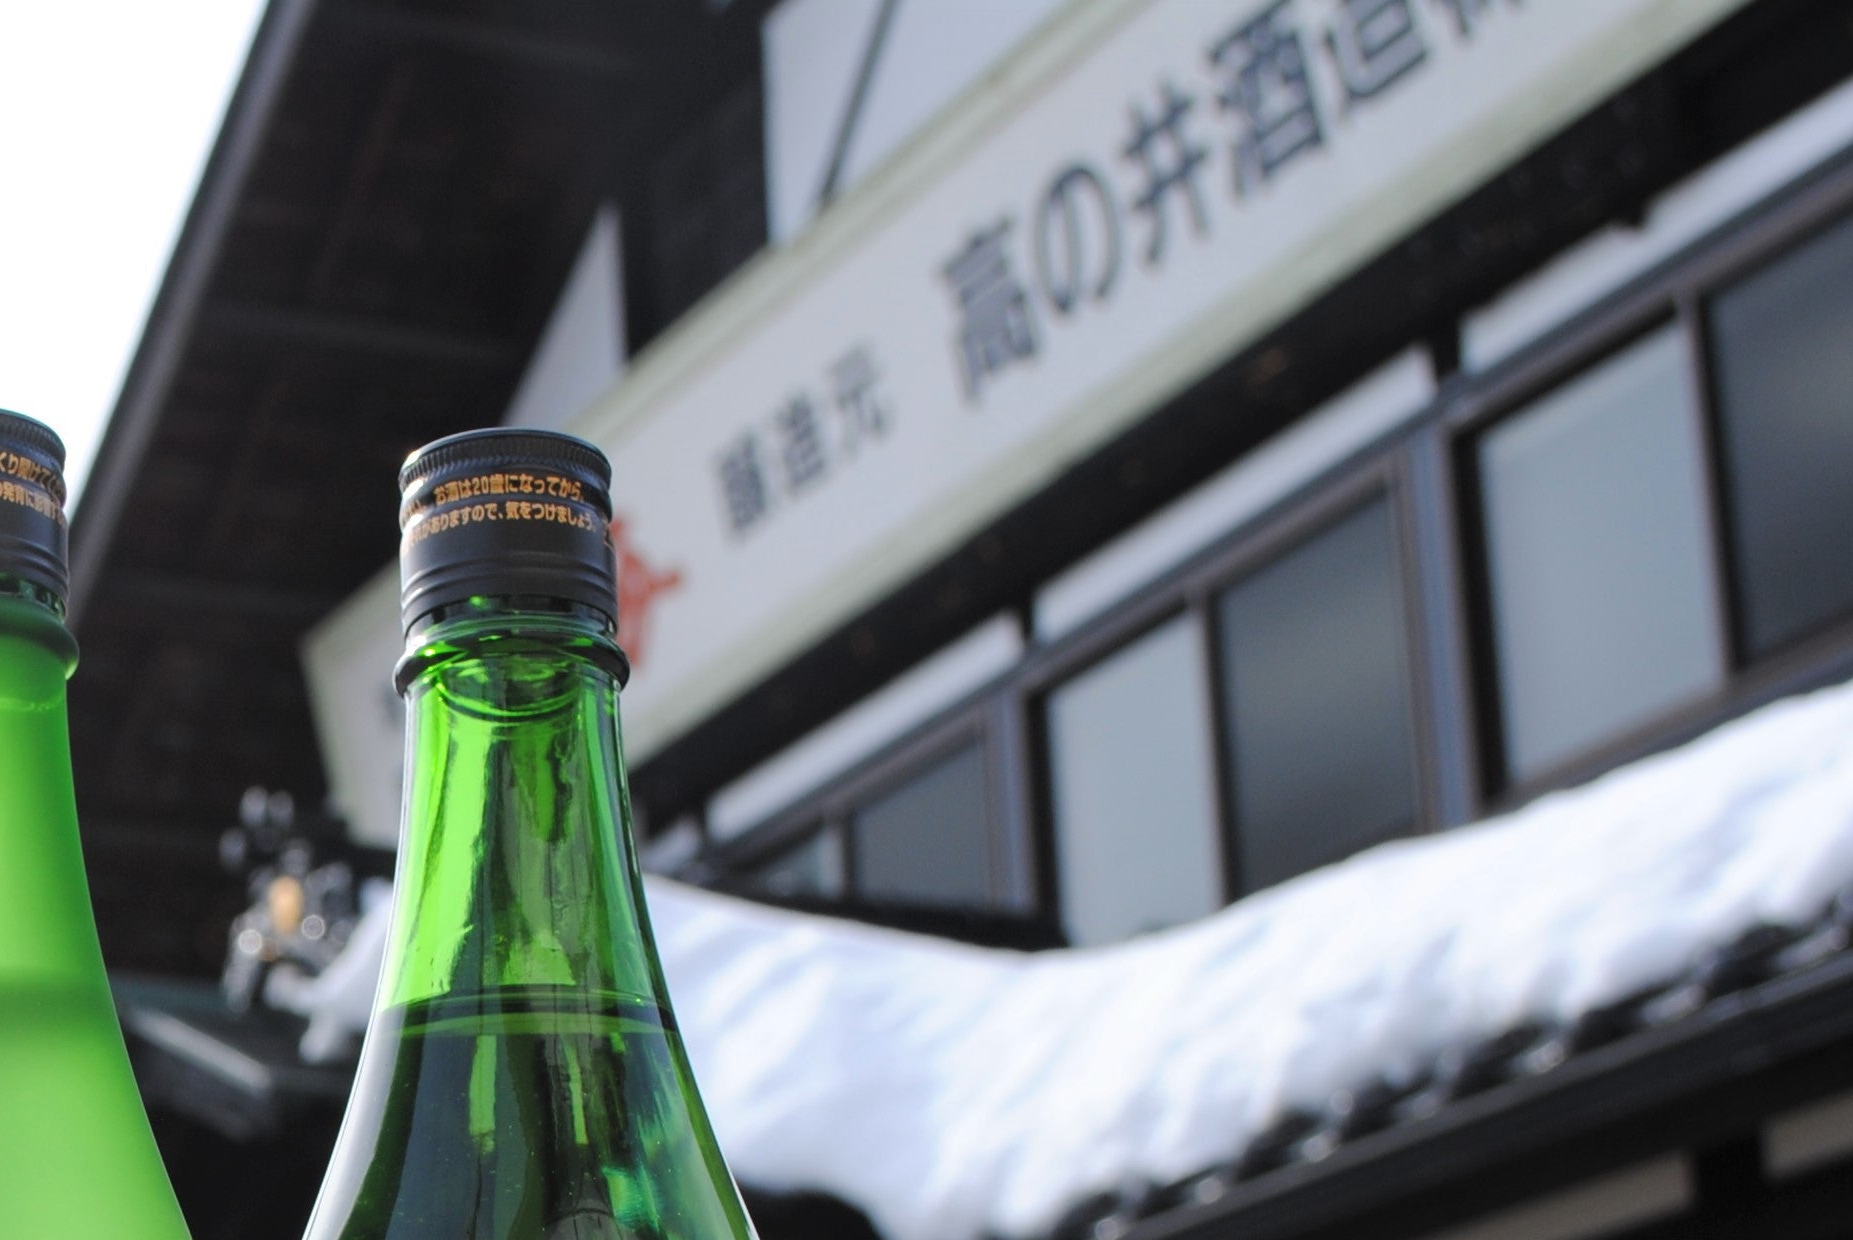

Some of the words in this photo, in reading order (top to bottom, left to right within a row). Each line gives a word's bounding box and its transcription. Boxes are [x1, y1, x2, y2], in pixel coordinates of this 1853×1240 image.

[943, 0, 1523, 402] 高の井酒造
